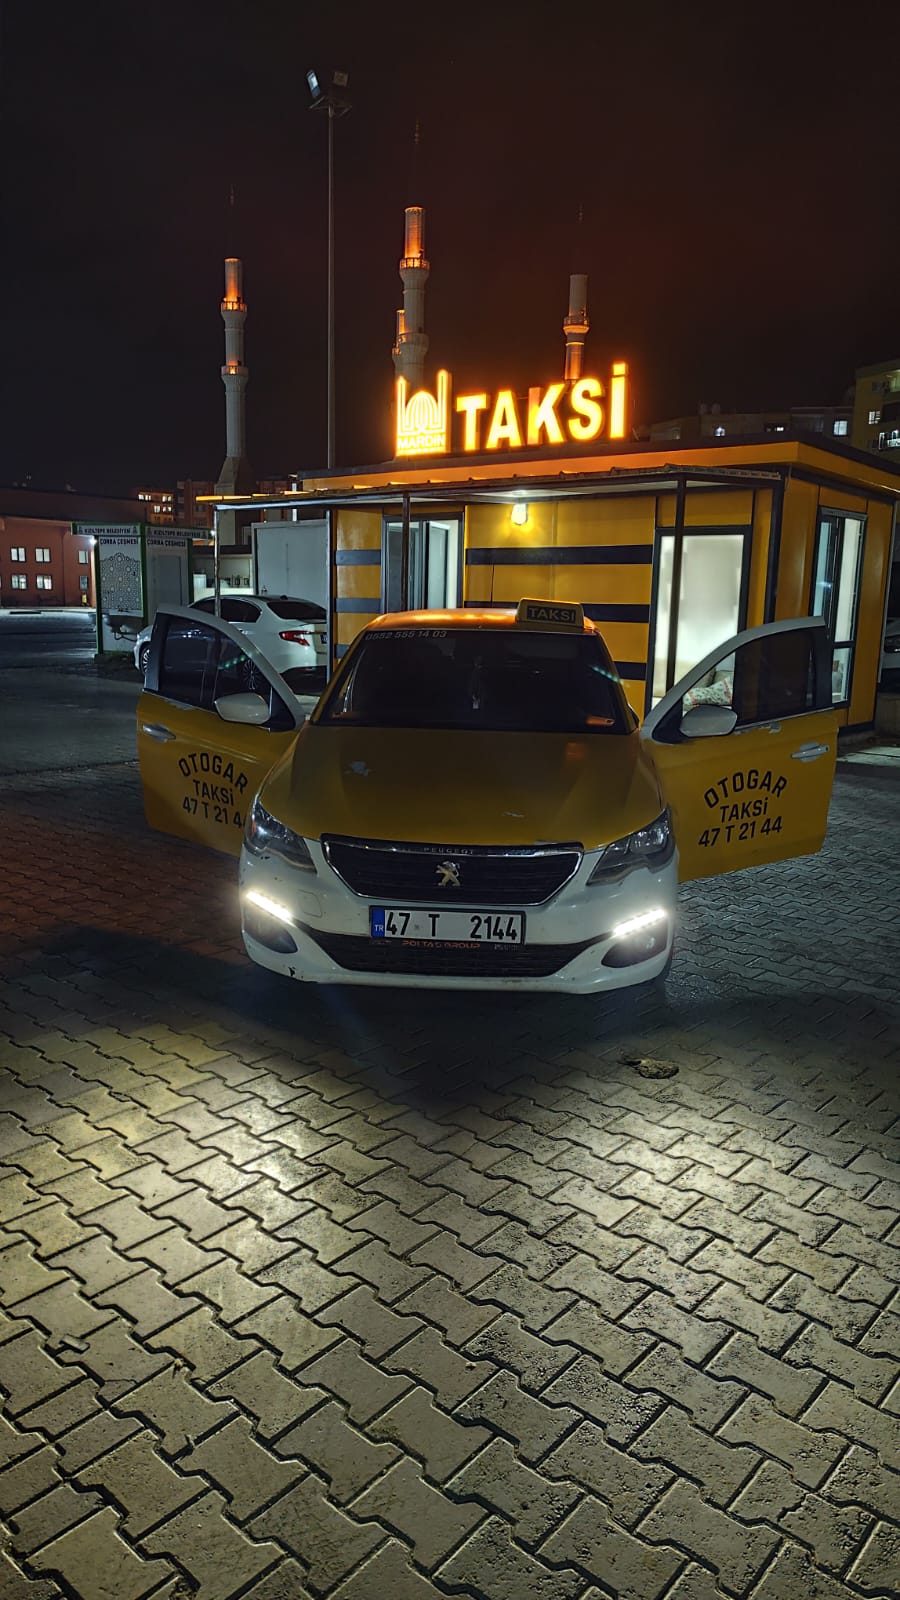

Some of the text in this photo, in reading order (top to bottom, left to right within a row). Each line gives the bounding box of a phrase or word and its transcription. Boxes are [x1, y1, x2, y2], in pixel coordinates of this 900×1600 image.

[456, 362, 627, 451] TAKSİ
[529, 607, 575, 622] TAKSI
[393, 631, 415, 639] 555
[432, 630, 447, 638] 03
[178, 752, 248, 795] OTOGAR
[703, 769, 787, 809] OTOGAR
[182, 796, 247, 829] 47 T 21 4
[698, 816, 783, 847] 47 T 21 44
[423, 847, 474, 855] PEUGEOT
[374, 924, 384, 932] TR
[386, 911, 517, 941] 47 T 2144
